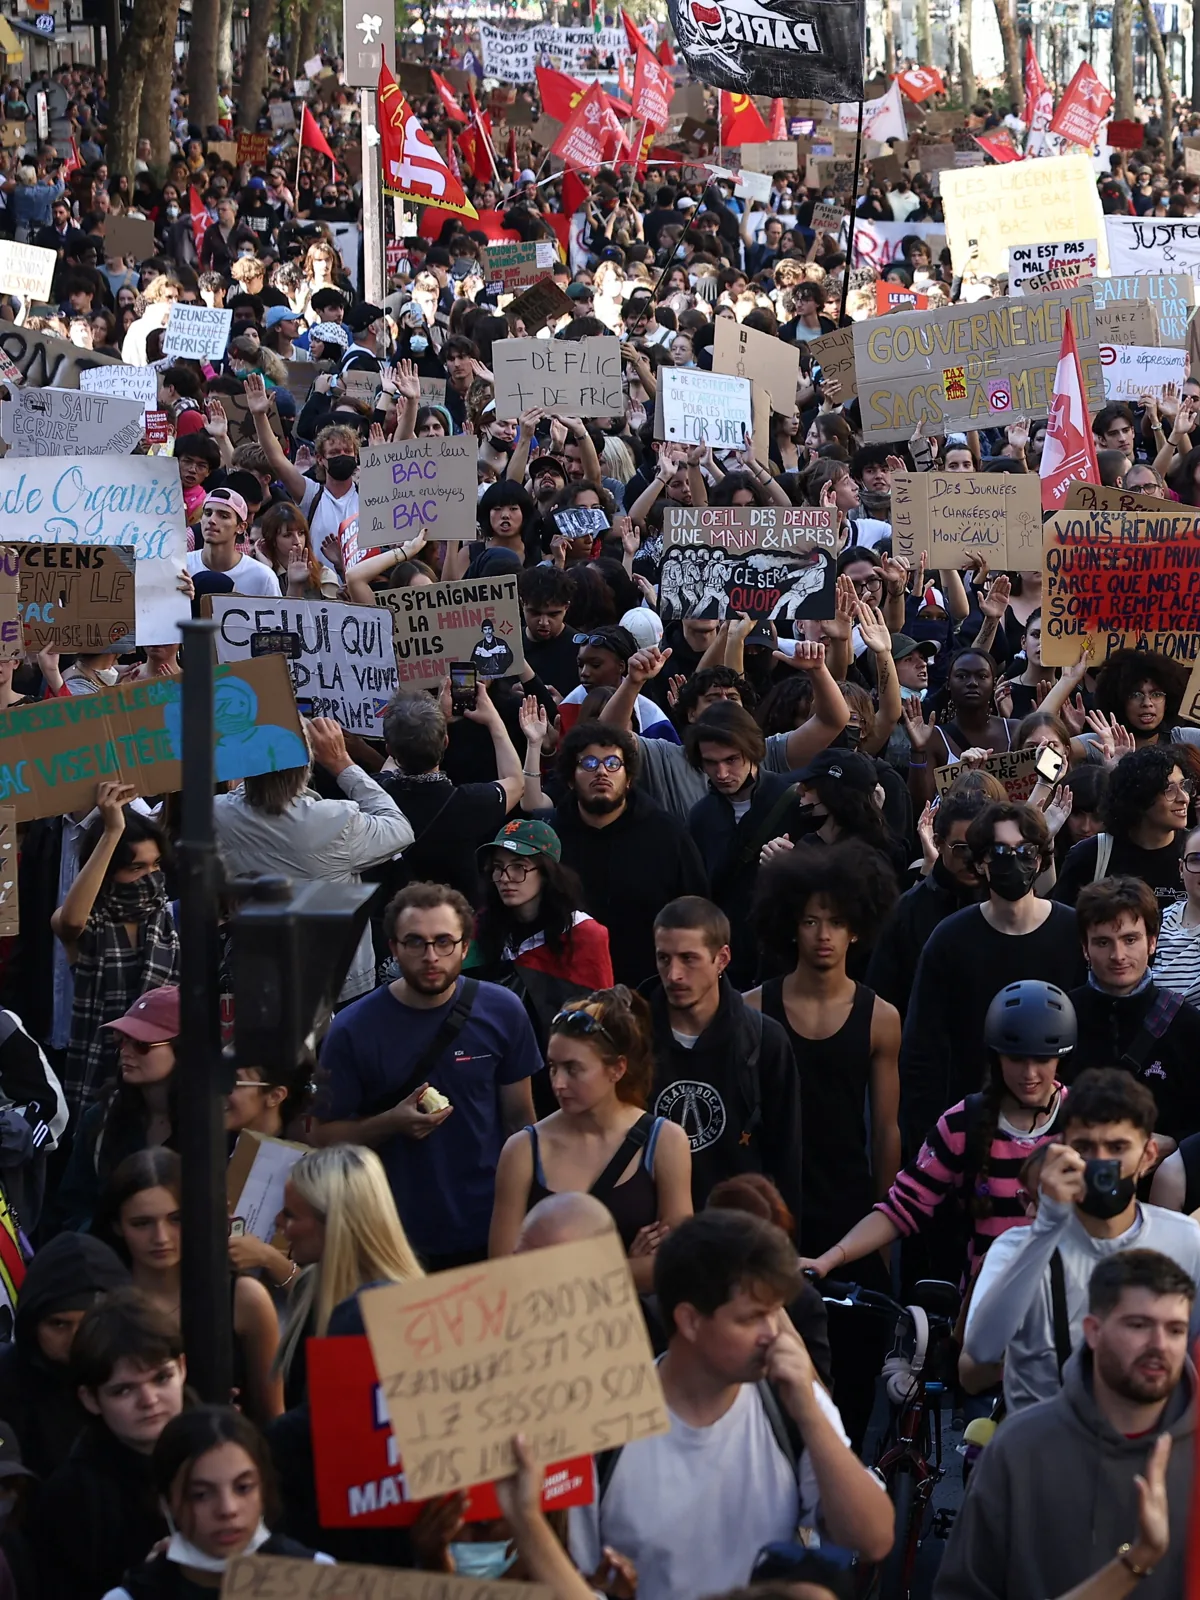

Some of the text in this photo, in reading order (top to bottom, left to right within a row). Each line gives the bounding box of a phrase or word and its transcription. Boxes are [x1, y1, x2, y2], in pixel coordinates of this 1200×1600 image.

[812, 218, 839, 230] FACHO
[1013, 242, 1085, 261] ON EST PAS
[1021, 260, 1045, 273] MAL
[888, 293, 900, 304] LE
[1149, 276, 1178, 299] LES
[173, 307, 227, 325] JEUNESSE
[1161, 297, 1188, 318] PAS
[867, 295, 1094, 365] GOUVERNEMENT
[165, 337, 220, 356] MÉPRISÉE
[943, 366, 965, 380] TAX
[1119, 351, 1187, 373] de répressions
[120, 377, 152, 390] POUR
[680, 376, 690, 386] DE
[542, 386, 569, 408] DE
[670, 389, 687, 401] QUE
[945, 389, 967, 401] RICH
[682, 403, 721, 417] POUR LES
[13, 408, 79, 443] ÉCRIRE
[363, 442, 471, 470] ils veulent leur
[391, 460, 438, 485] BAC
[364, 483, 466, 508] vous leur envoyez
[929, 477, 1017, 500] DES JOURNÉES
[370, 499, 439, 533] la BAC
[670, 509, 831, 527] UN OEIL DES DENTS
[942, 505, 1008, 522] CHARGÉES QUE
[670, 527, 836, 549] UNE MAIN & APRÈS
[932, 526, 999, 544] MON CAVU
[1119, 516, 1189, 545] RENDEZ
[1046, 545, 1120, 578] QU'ON SE
[733, 565, 790, 589] CE SERA
[1048, 574, 1104, 597] PARCE
[1148, 572, 1181, 594] NOS
[1049, 596, 1107, 618] SONT
[408, 614, 429, 633] LA
[1097, 614, 1152, 634] NOTRE
[34, 623, 104, 647] VISE LA
[350, 665, 399, 693] VEUVE
[402, 1288, 508, 1362] ACAB
[522, 1330, 570, 1371] LES
[474, 1375, 593, 1434] GOSSES
